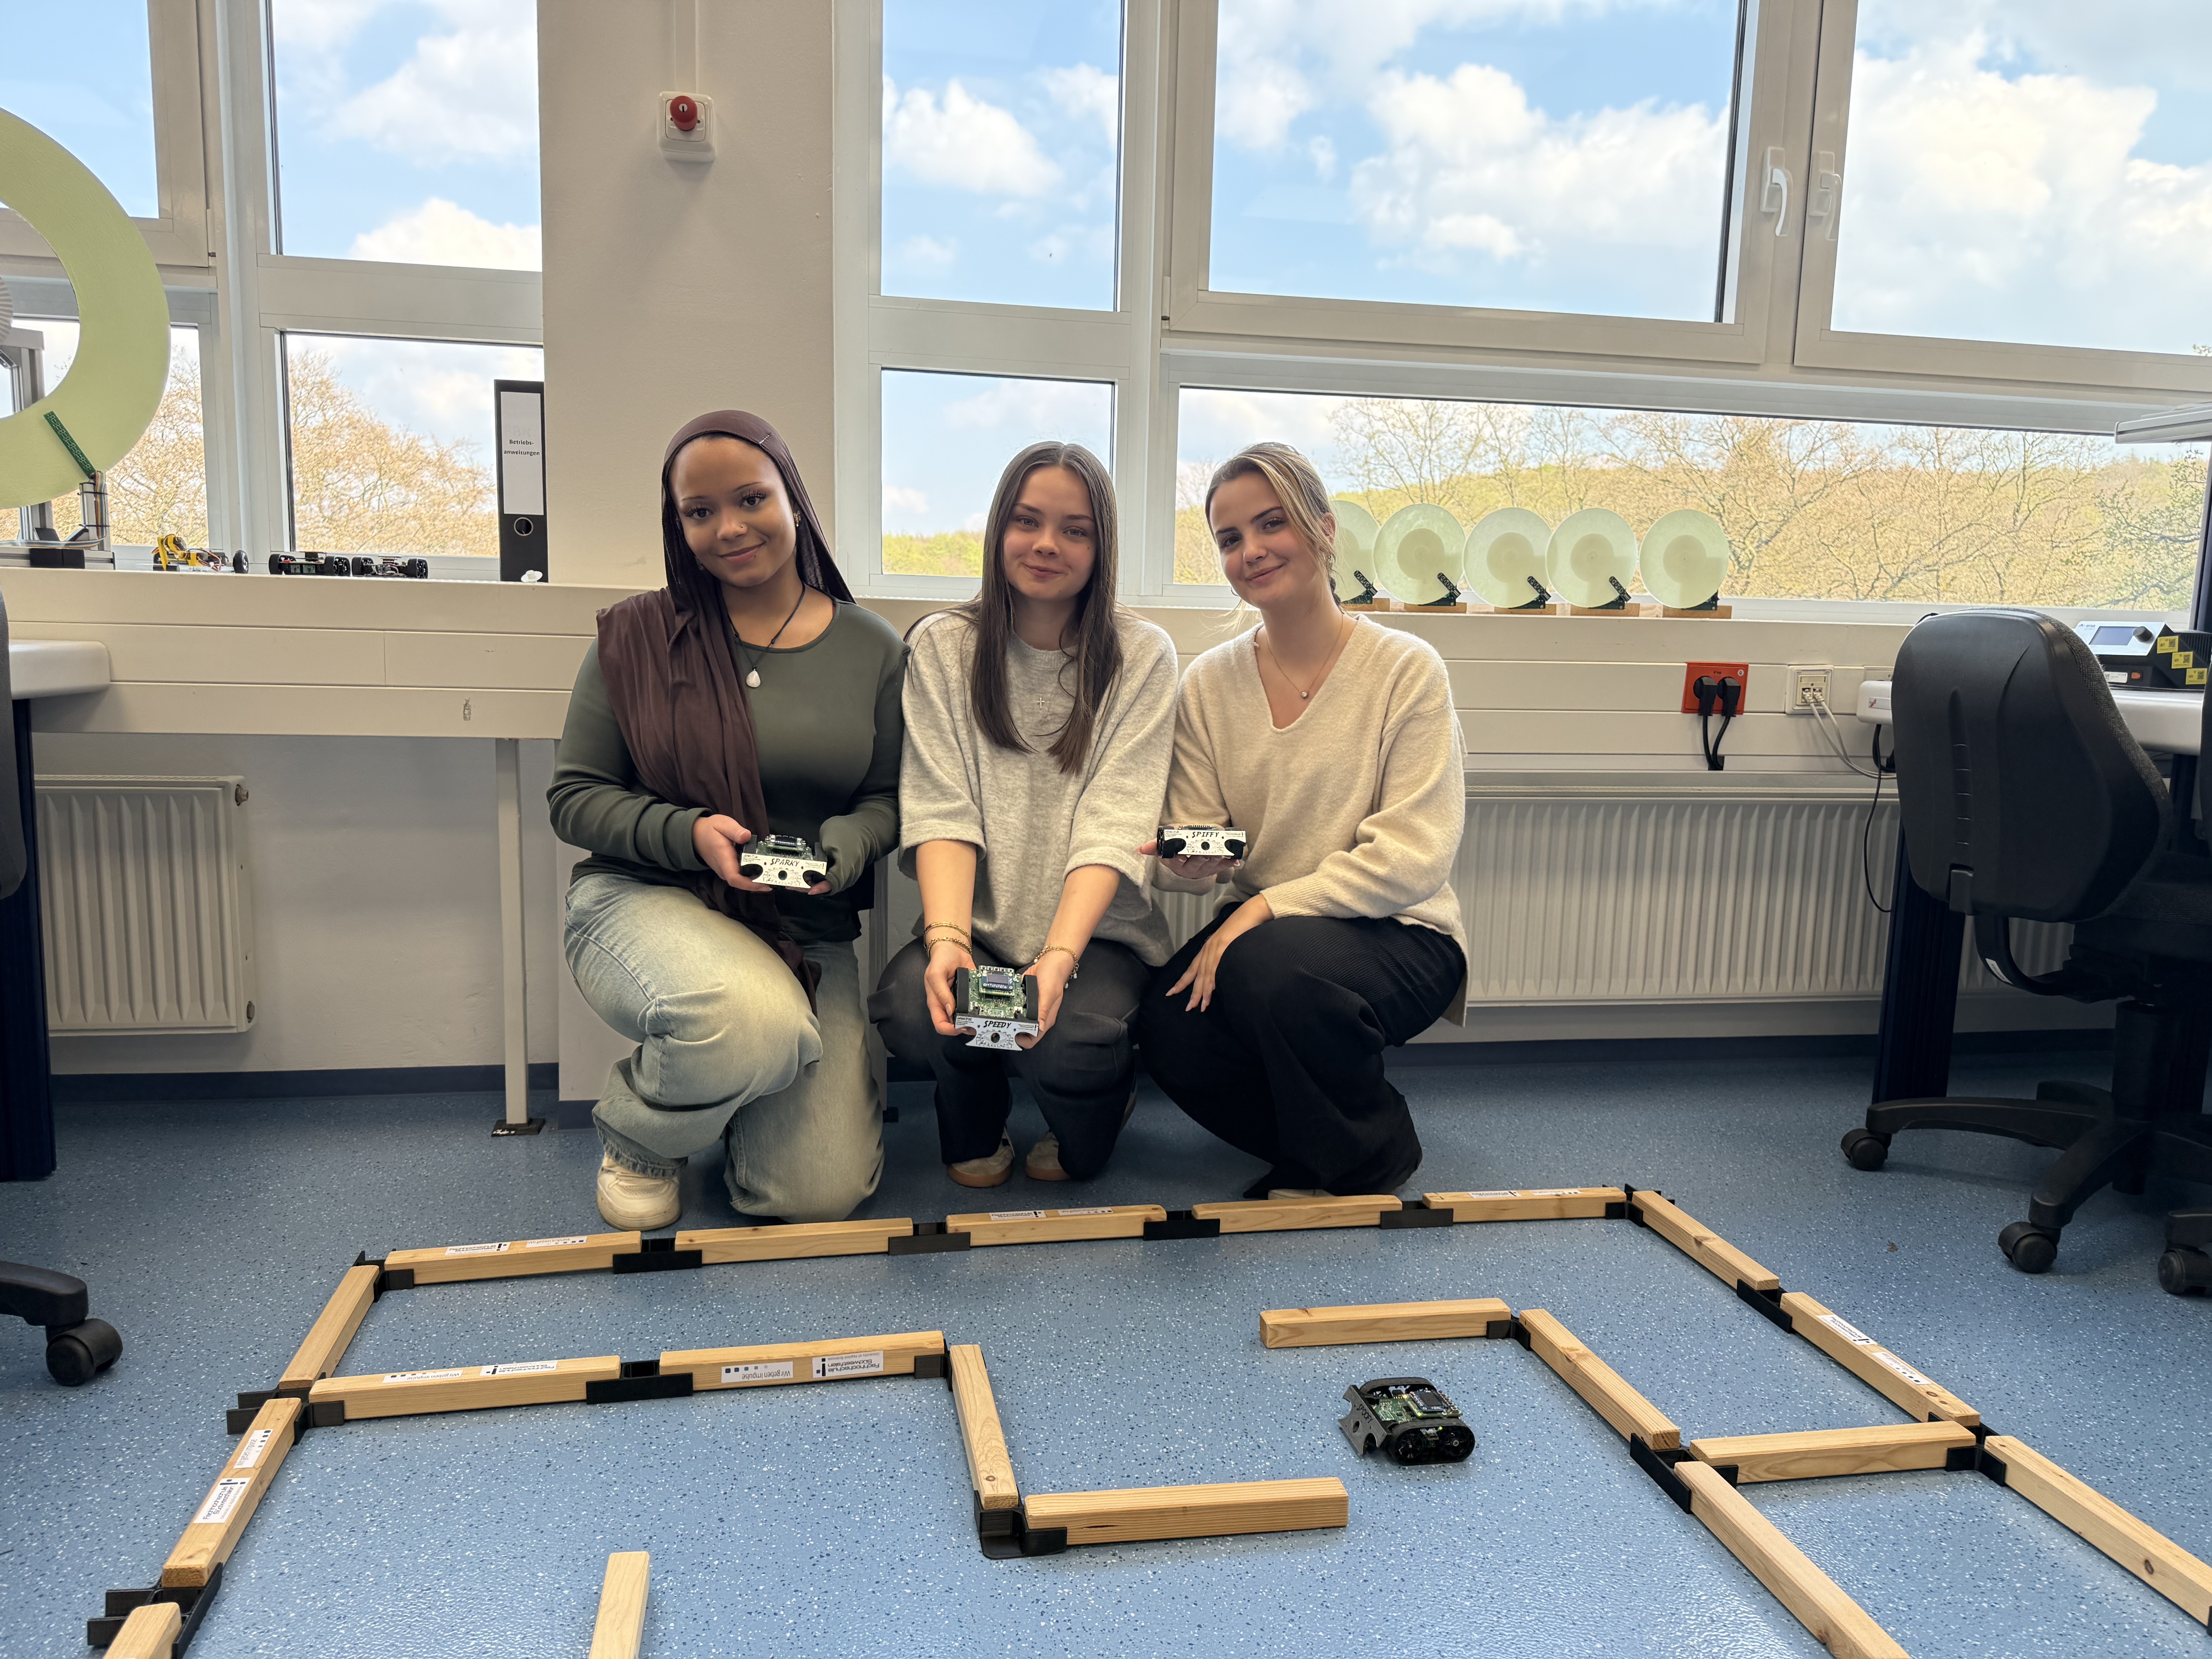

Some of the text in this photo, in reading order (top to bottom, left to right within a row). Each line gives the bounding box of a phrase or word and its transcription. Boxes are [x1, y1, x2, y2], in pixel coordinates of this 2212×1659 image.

[770, 858, 800, 867] SPARKY
[983, 1020, 1012, 1029] SPEEDY
[828, 1363, 879, 1373] Fachhochschule
[742, 1372, 763, 1380] Impulse
[764, 1370, 781, 1378] geben
[1357, 1404, 1374, 1424] SPOOFY
